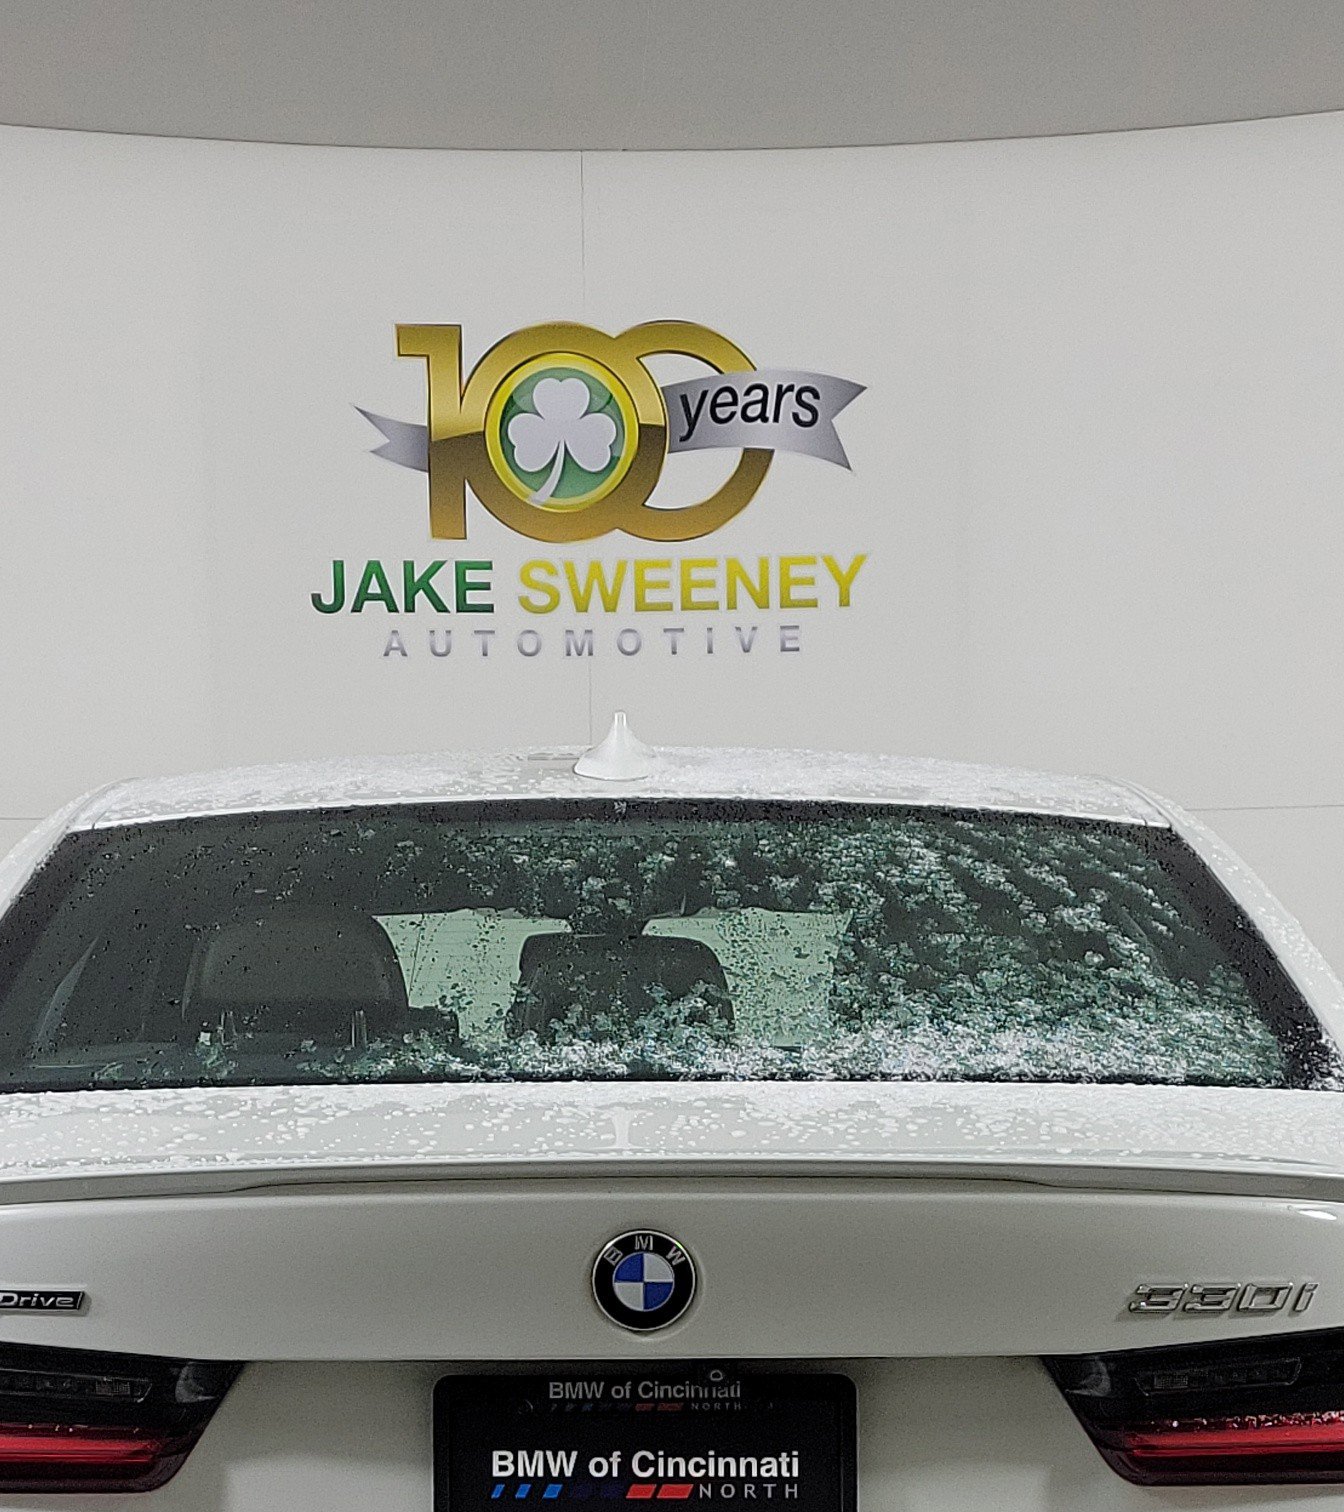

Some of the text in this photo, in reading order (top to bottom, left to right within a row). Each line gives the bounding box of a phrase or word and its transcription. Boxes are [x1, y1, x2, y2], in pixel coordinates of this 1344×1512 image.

[394, 319, 821, 543] 100 years
[311, 552, 867, 616] JAKE SWEENEY
[382, 625, 802, 658] AUTOMOTIVE
[1129, 1282, 1320, 1312] 330i
[549, 1381, 605, 1399] BMW
[611, 1381, 632, 1399] of
[491, 1450, 799, 1478] BMW of Cincinnati
[699, 1484, 799, 1499] NORTH
